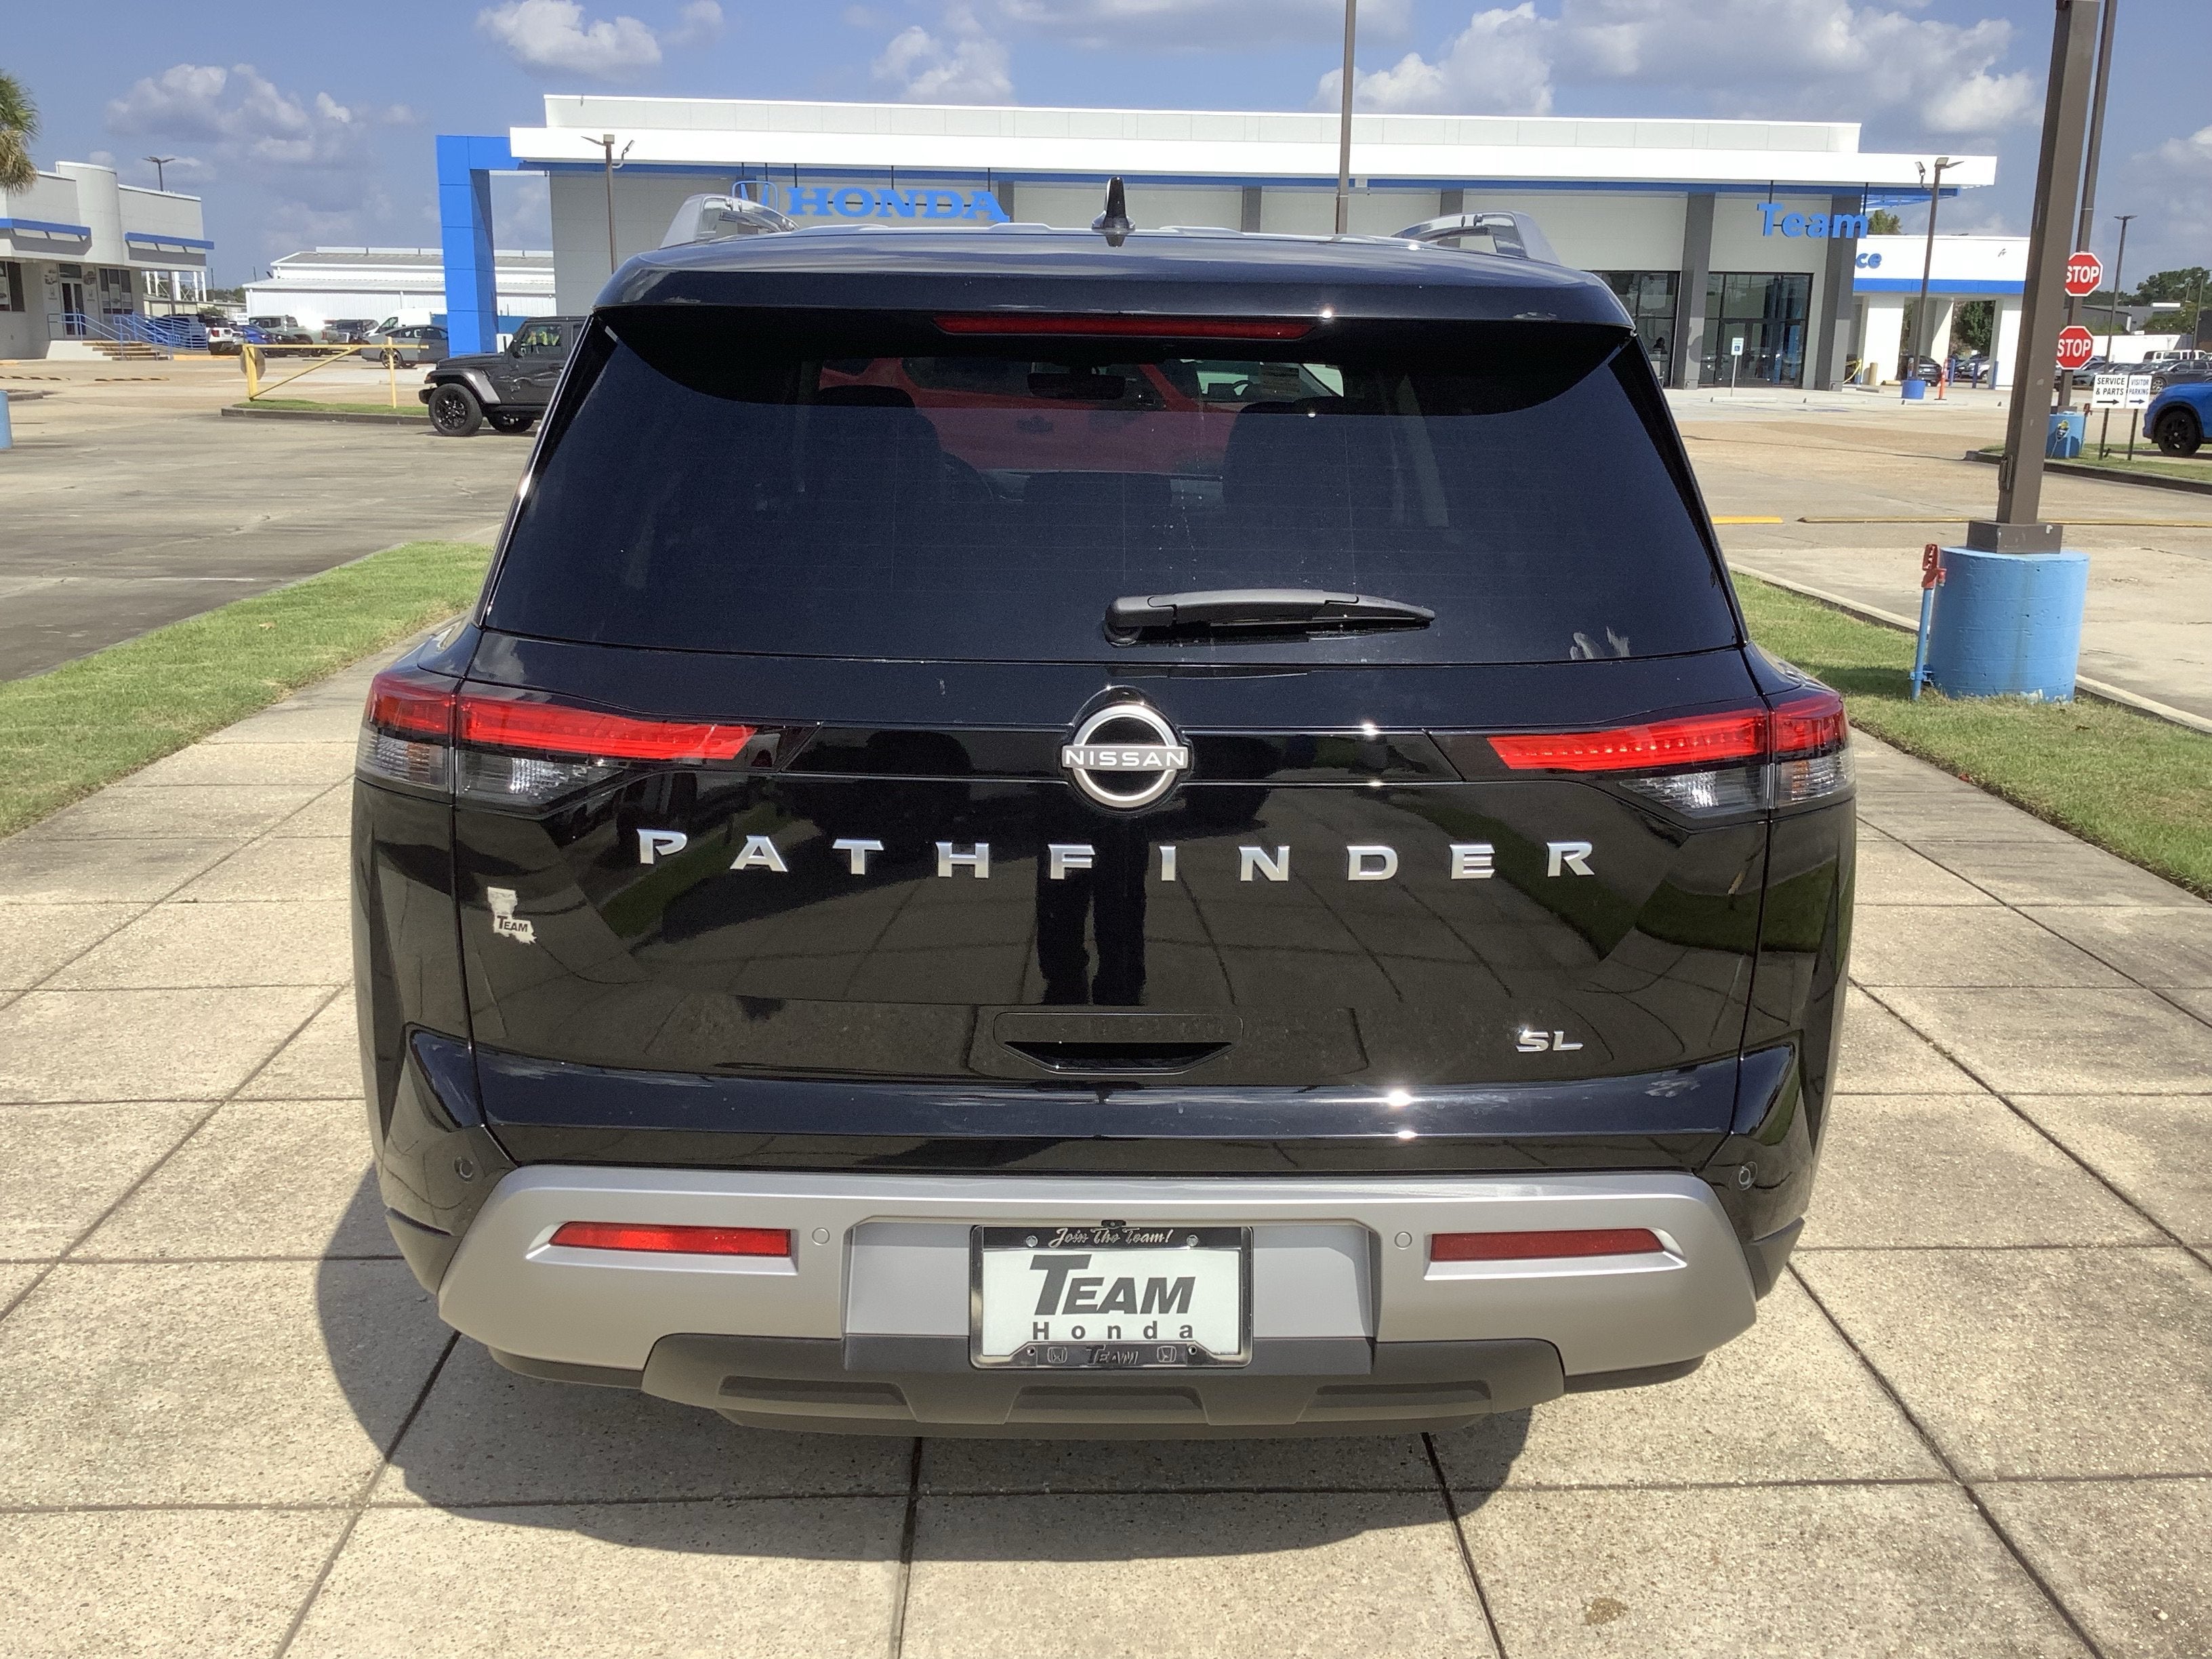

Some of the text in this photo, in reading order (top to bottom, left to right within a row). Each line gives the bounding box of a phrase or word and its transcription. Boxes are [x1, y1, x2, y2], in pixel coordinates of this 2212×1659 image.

[786, 187, 1010, 222] HONDA
[1757, 203, 1869, 239] Team
[2066, 266, 2100, 283] STOP
[2057, 339, 2091, 357] STOP
[2097, 377, 2125, 386] SERVICE
[1065, 750, 1185, 766] NISSAN
[636, 828, 1595, 881] PATHFINDER
[497, 915, 528, 933] TEAM
[1515, 1030, 1584, 1052] SL
[1048, 1227, 1174, 1248] Join The Team!
[1029, 1254, 1196, 1316] TEAM
[1032, 1321, 1194, 1340] Honda
